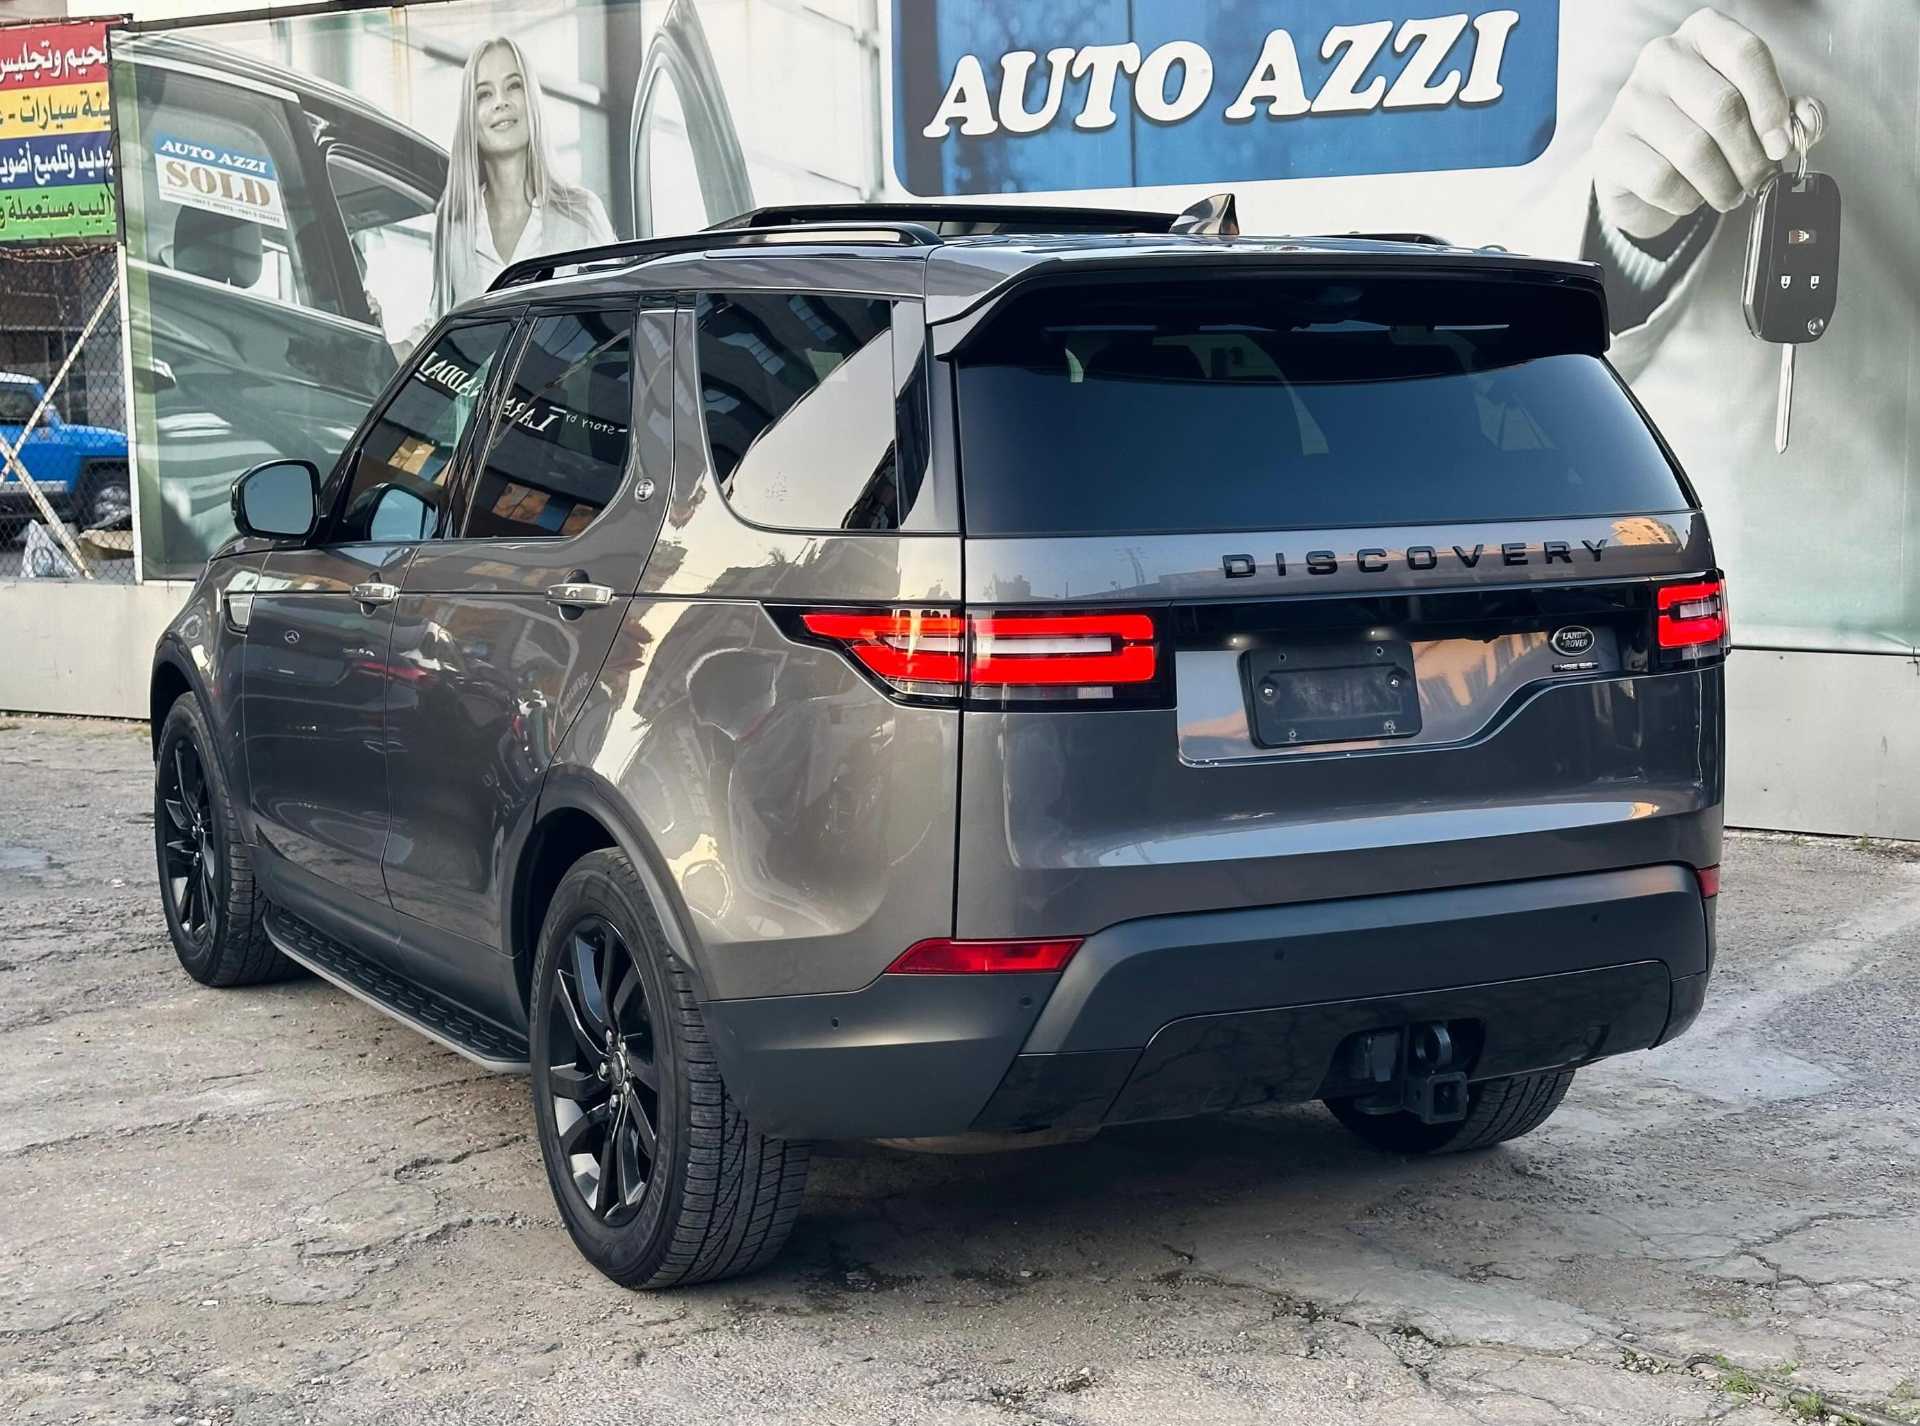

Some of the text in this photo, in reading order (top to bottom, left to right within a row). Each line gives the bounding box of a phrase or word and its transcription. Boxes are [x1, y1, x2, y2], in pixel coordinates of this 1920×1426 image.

[65, 34, 108, 78] لحيم
[922, 10, 1519, 138] AUTO AZZI
[20, 94, 78, 130] سيارات
[82, 90, 111, 125] ينة
[0, 141, 114, 185] جديد وتلميع أضوي
[160, 139, 268, 174] AUTO AZZI
[165, 160, 271, 207] SOLD
[5, 195, 75, 221] مستعملة
[79, 192, 114, 226] اليب
[1222, 538, 1609, 578] DISCOVERY
[1562, 631, 1585, 640] LAND
[1565, 639, 1588, 648] ROVER
